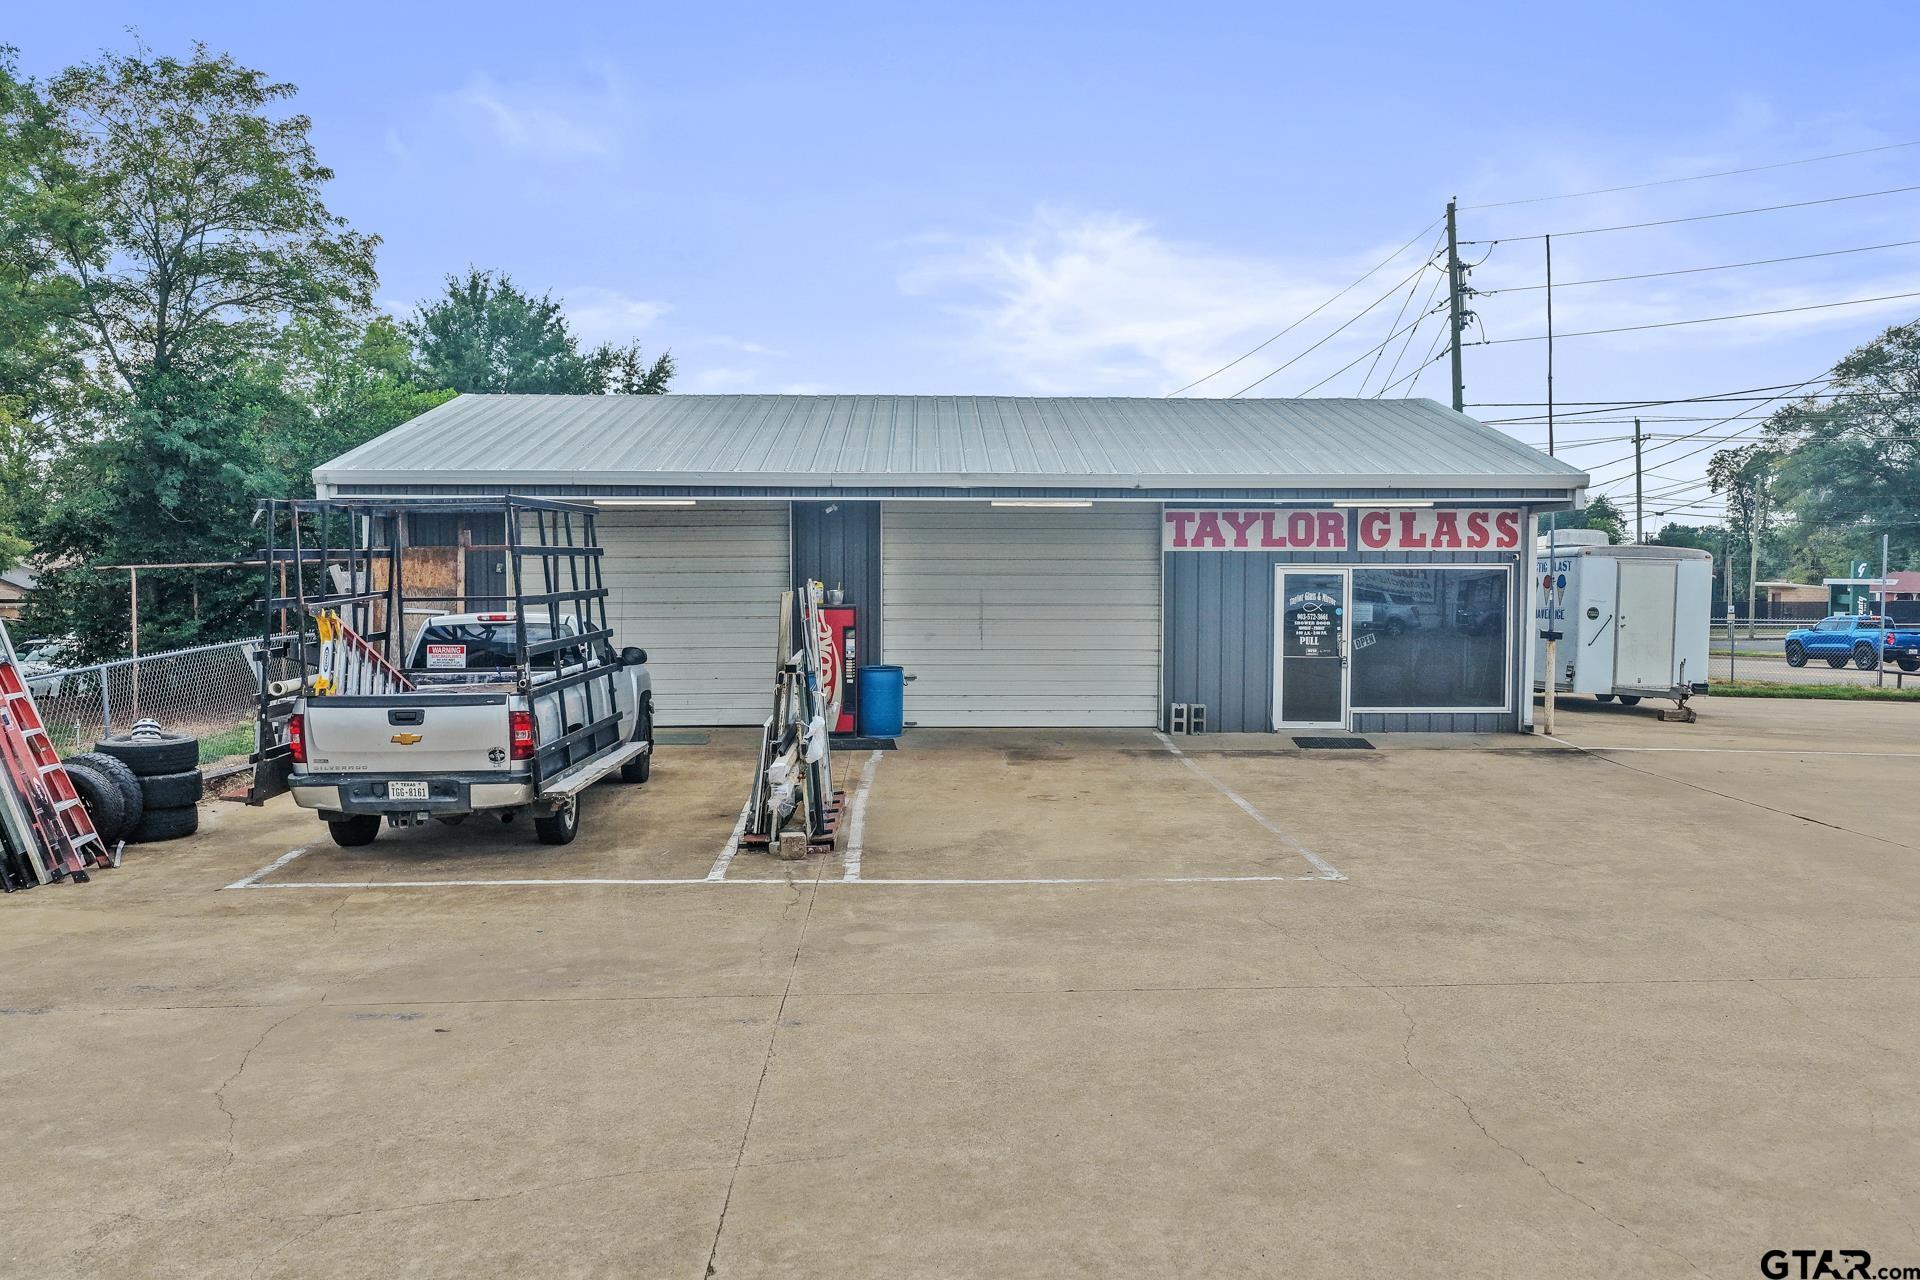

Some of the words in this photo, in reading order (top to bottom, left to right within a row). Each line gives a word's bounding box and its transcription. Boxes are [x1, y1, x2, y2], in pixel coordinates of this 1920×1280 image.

[1165, 511, 1346, 547] TAYLOR
[1360, 511, 1519, 548] GLASS
[1552, 560, 1572, 572] LAST
[1299, 636, 1320, 646] PULL
[1355, 634, 1376, 648] OPEN
[432, 646, 461, 654] WARNING
